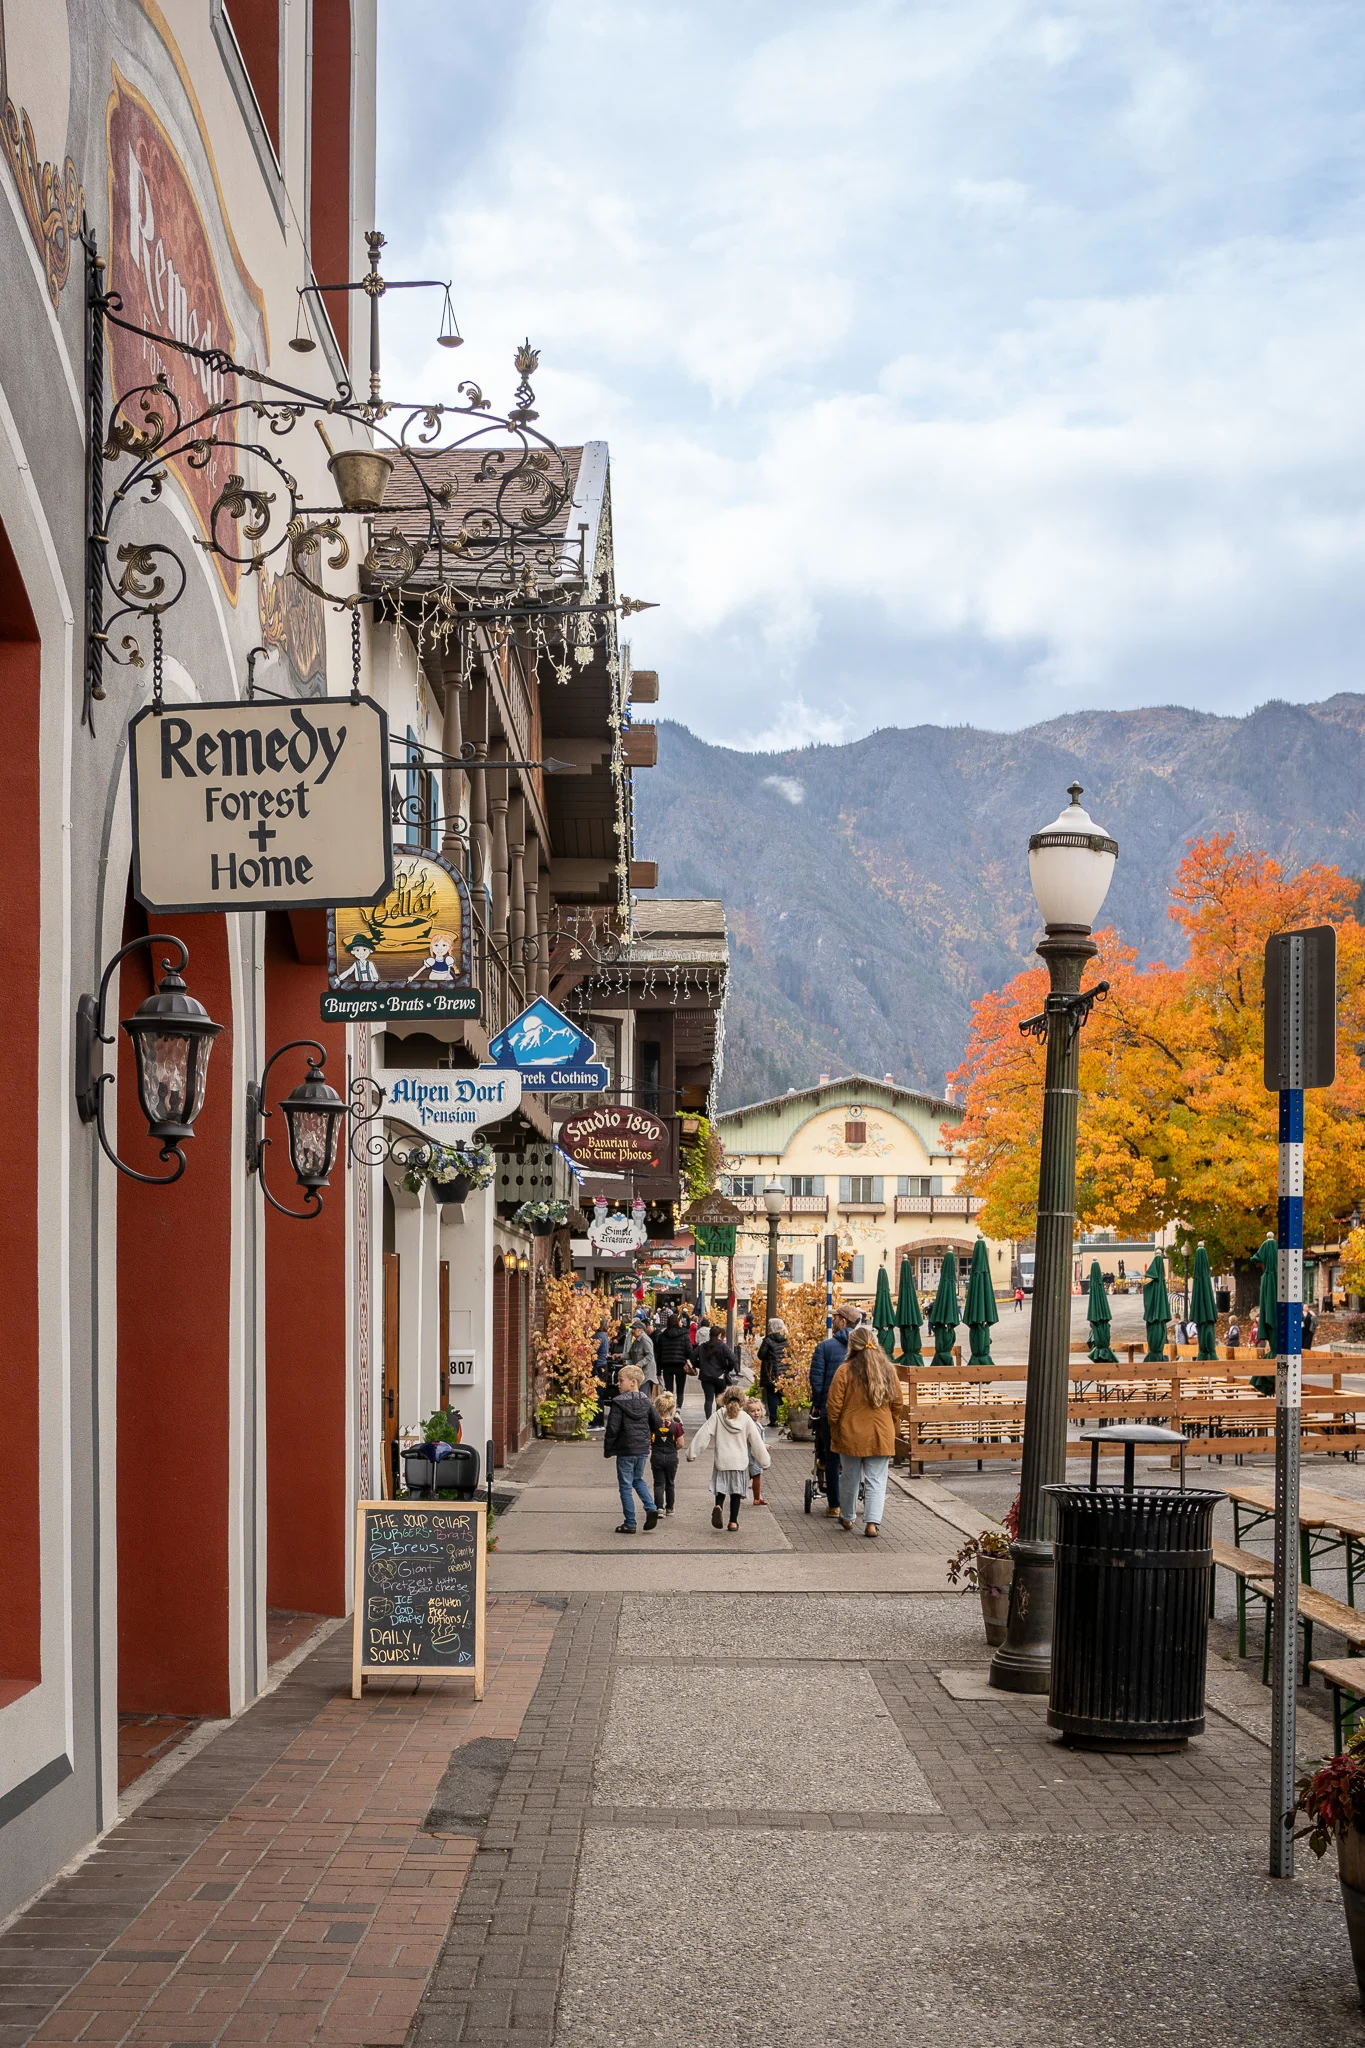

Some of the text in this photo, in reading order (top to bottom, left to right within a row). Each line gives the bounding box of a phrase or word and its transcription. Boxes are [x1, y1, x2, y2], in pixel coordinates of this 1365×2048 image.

[128, 141, 225, 437] Remedy
[160, 708, 347, 784] Remedy
[205, 781, 310, 822] Forest
[248, 820, 276, 852] +
[211, 852, 314, 890] Home
[371, 889, 437, 926] Cellar
[324, 995, 476, 1018] Burgers Brats Brews
[550, 1070, 599, 1086] Clothing
[388, 1078, 506, 1107] Alpen Dorf
[419, 1106, 477, 1125] Pension
[566, 1108, 660, 1142] Studio 1890
[587, 1136, 629, 1148] Bavarian
[573, 1148, 652, 1162] Old Time Photos
[700, 1242, 733, 1253] STEIN
[450, 1361, 473, 1375] 807
[367, 1514, 399, 1529] THE
[403, 1514, 429, 1529] SOUP
[371, 1528, 475, 1542] BURGERS Brats
[391, 1542, 440, 1555] Brews
[397, 1561, 435, 1578] Giant
[394, 1595, 413, 1605] ICE
[370, 1628, 412, 1646] DAILY
